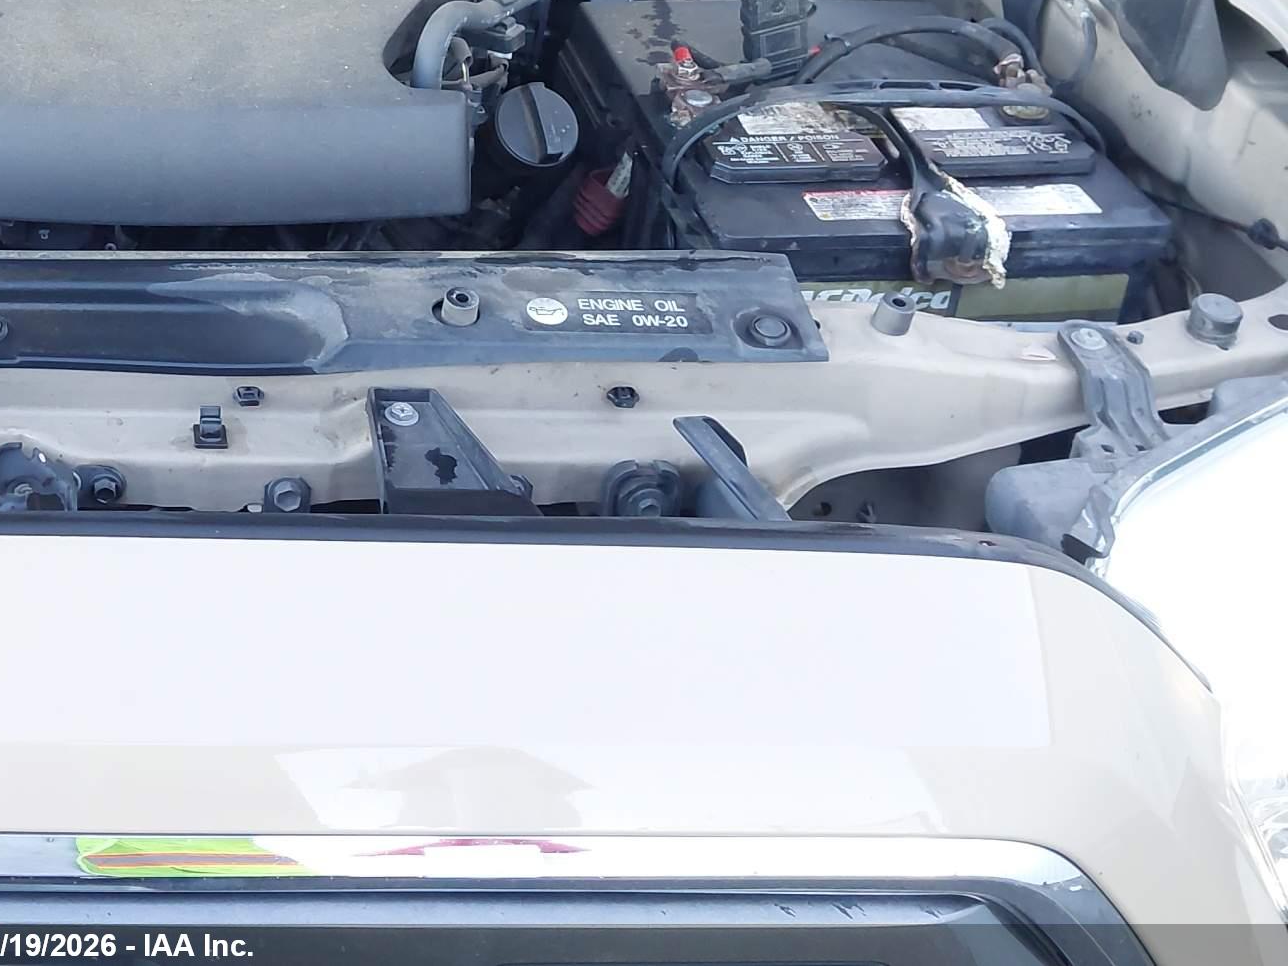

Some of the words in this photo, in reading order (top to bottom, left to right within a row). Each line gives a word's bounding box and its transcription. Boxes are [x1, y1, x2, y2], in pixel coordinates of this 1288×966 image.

[577, 298, 645, 312] ENGINE
[654, 299, 686, 313] OIL
[800, 287, 952, 309] CDco
[582, 313, 621, 327] SAE
[631, 315, 688, 328] 0W-20
